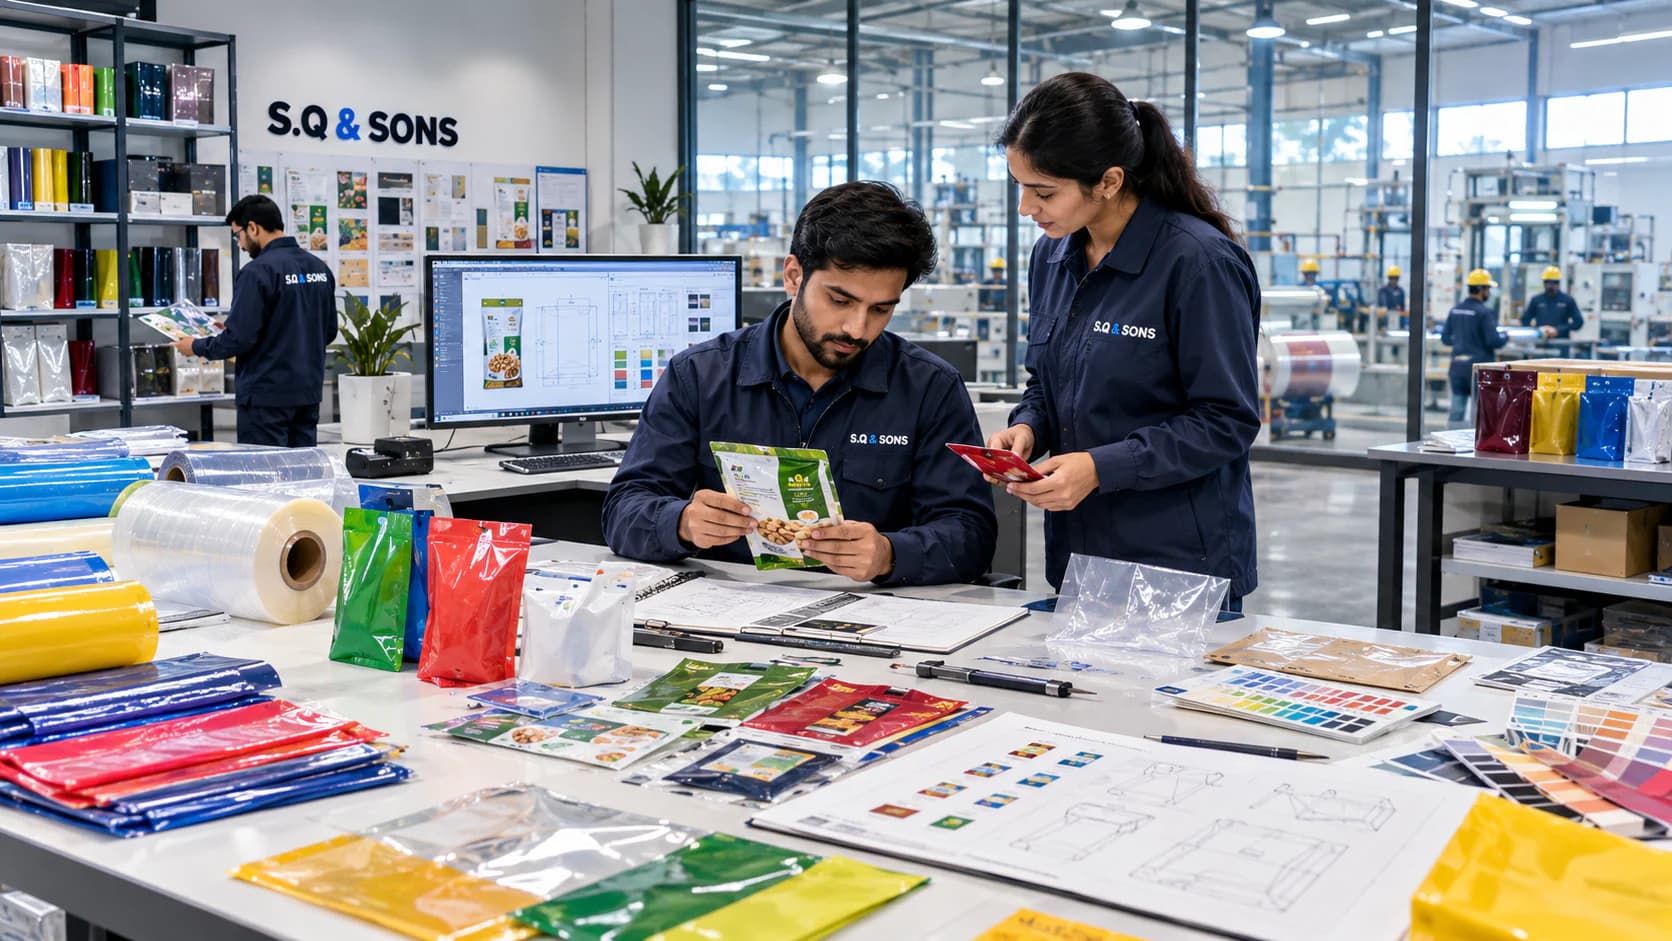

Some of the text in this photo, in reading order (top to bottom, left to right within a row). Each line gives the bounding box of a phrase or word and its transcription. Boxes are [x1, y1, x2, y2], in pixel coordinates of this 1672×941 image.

[268, 101, 459, 147] S.Q & SONS
[306, 273, 327, 283] SONS
[1093, 320, 1156, 339] S.Q & SONS
[850, 433, 909, 446] S.Q & SONS
